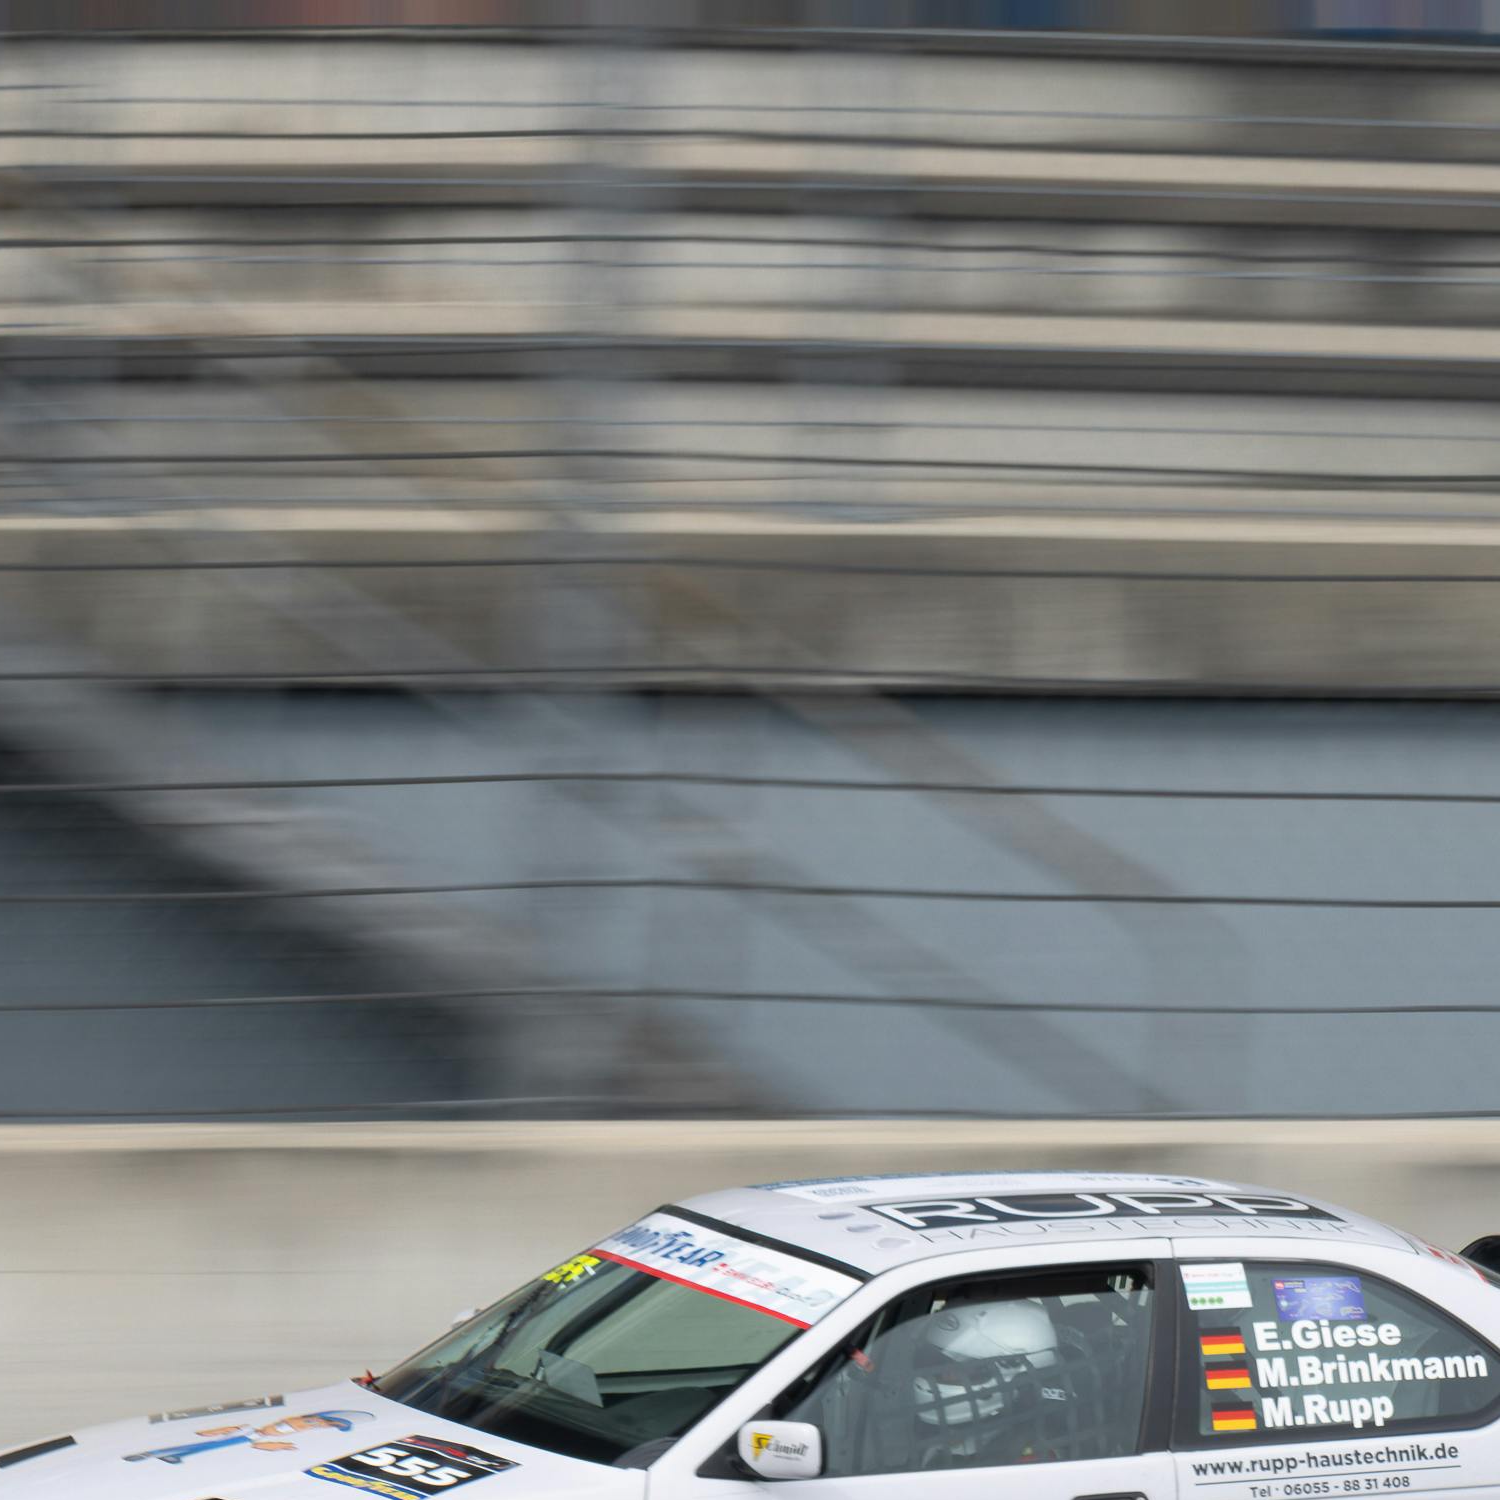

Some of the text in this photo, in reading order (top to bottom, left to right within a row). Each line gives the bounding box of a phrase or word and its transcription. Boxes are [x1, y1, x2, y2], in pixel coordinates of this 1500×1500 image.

[871, 1191, 1310, 1228] RUPP
[919, 1217, 1368, 1243] HAUSTECHNIK
[1253, 1319, 1401, 1351] E.Giese
[1256, 1352, 1489, 1388] M.Brinkmann
[1262, 1394, 1394, 1428] M.Rupp
[351, 1447, 473, 1487] 555
[1192, 1443, 1459, 1476] www.rupp-haustechnik.de
[1250, 1486, 1271, 1498] Tel
[1284, 1481, 1330, 1496] 06055
[1344, 1479, 1360, 1492] 88
[1365, 1478, 1379, 1490] 31
[1383, 1476, 1411, 1489] 408
